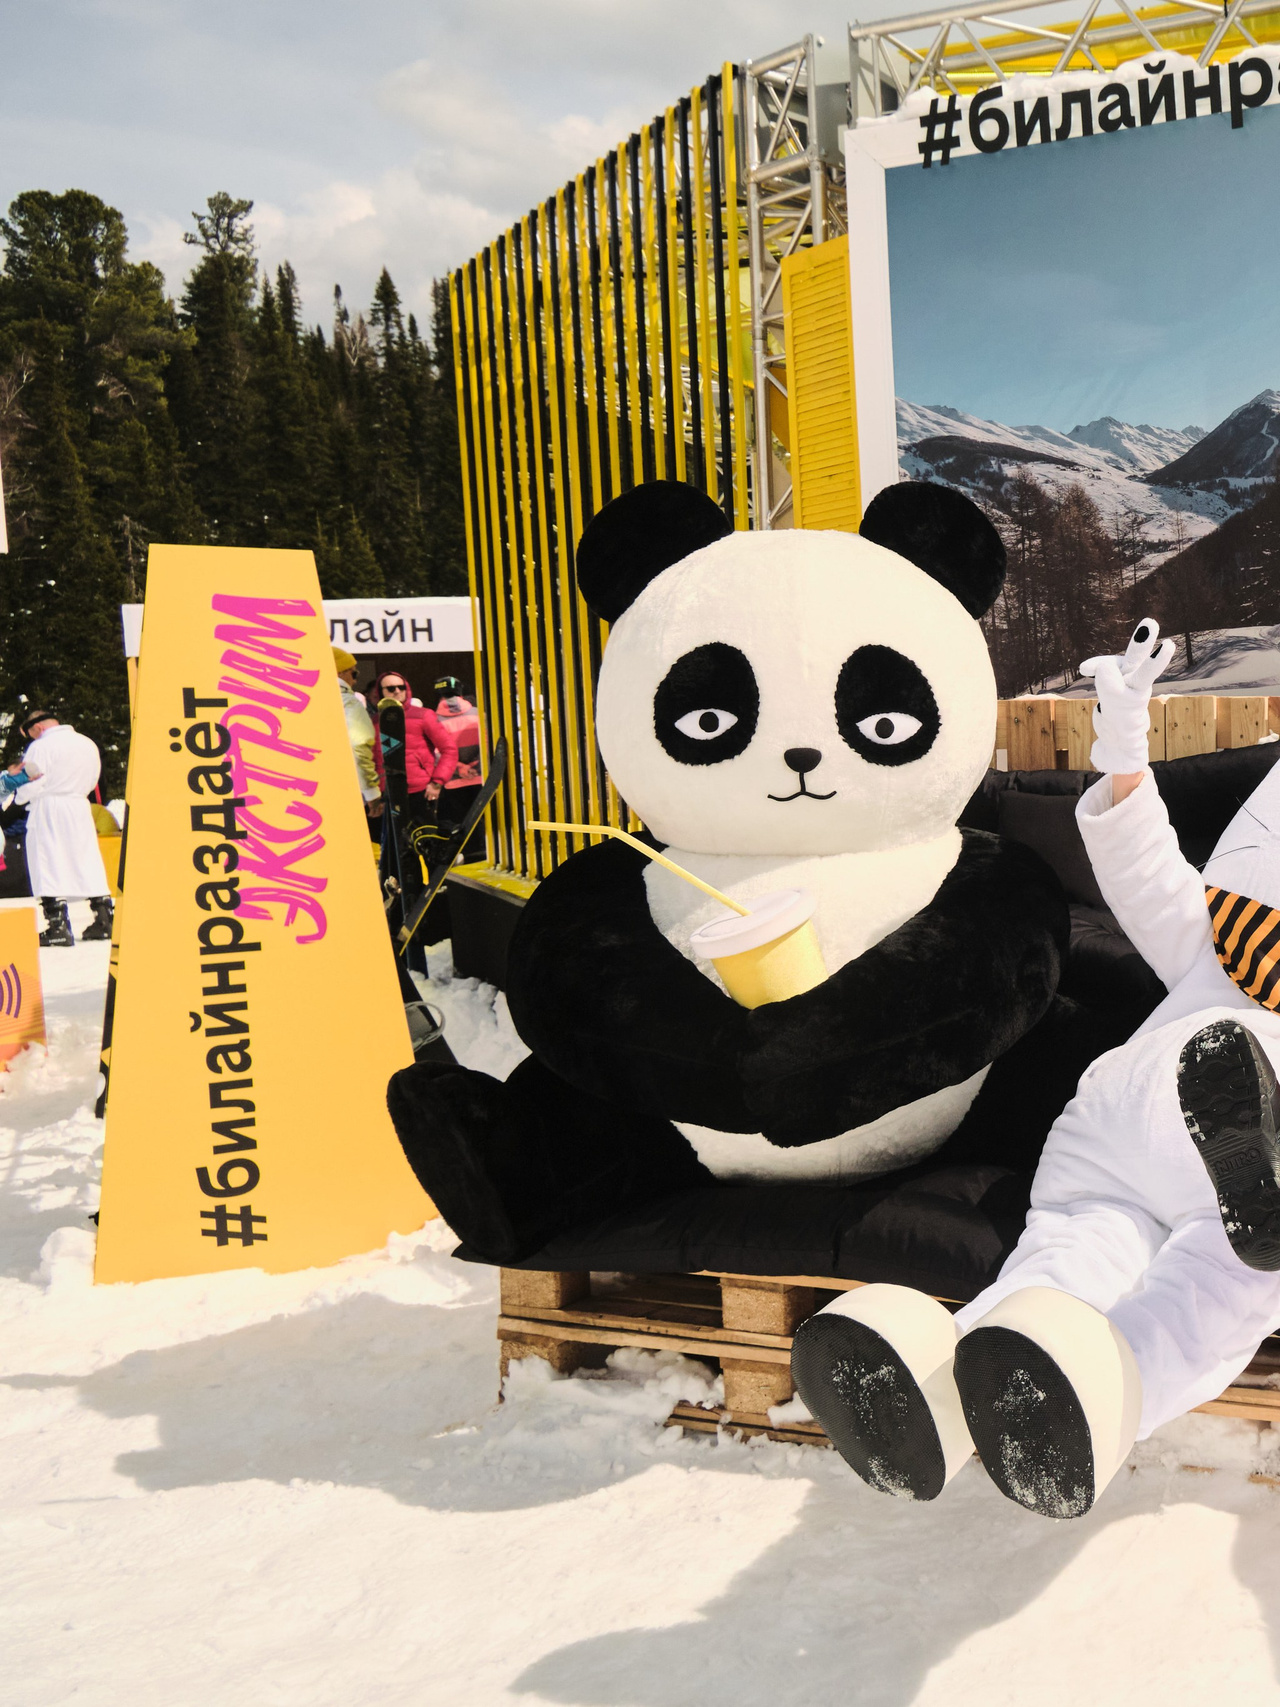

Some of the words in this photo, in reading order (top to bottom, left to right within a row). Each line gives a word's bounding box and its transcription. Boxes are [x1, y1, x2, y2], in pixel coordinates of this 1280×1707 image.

[329, 610, 433, 643] лайн
[211, 593, 328, 945] ЭКСТРИМ
[168, 687, 268, 1247] #билайнраздаёт
[1214, 1148, 1261, 1177] NITRO
